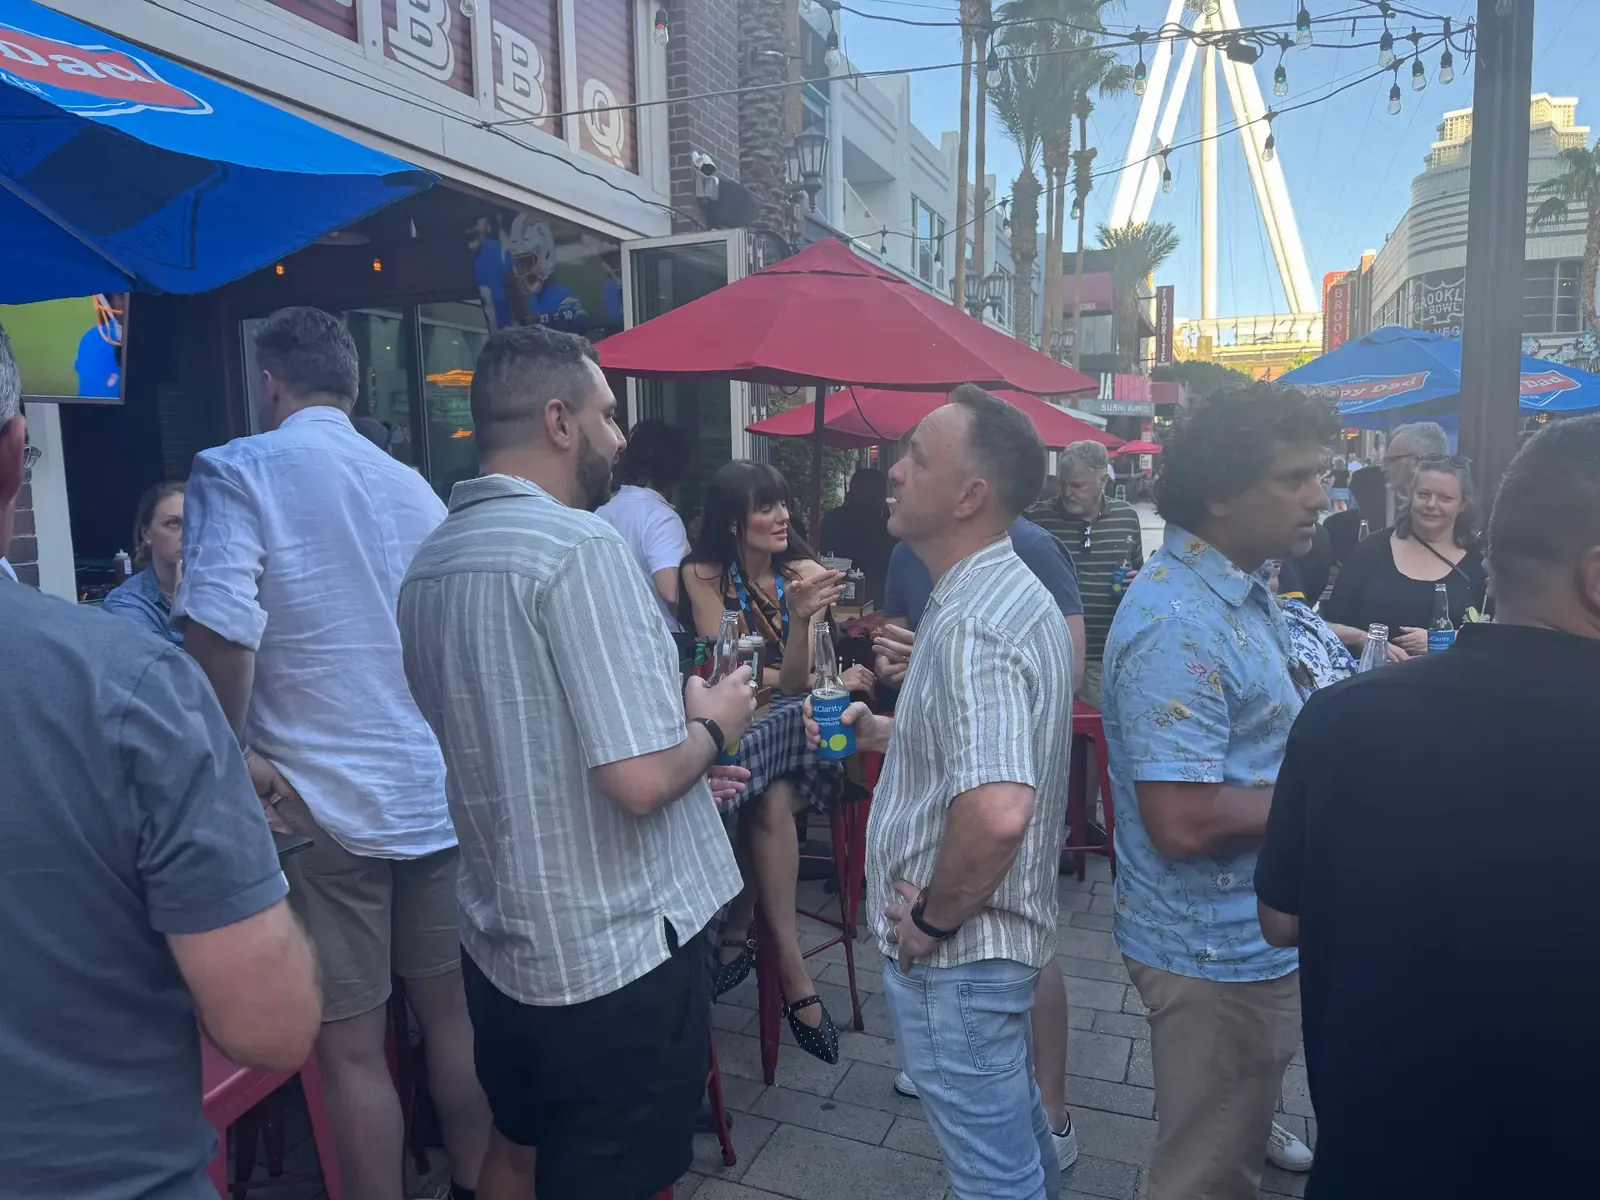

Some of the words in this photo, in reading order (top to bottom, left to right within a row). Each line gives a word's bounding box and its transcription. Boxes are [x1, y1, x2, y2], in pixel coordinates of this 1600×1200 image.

[388, 0, 625, 168] BBQ
[1415, 287, 1463, 314] BROOKL
[1429, 302, 1460, 315] BOWL
[1434, 325, 1461, 337] VEG
[1371, 377, 1417, 393] Dad
[1101, 403, 1125, 412] SUSHI
